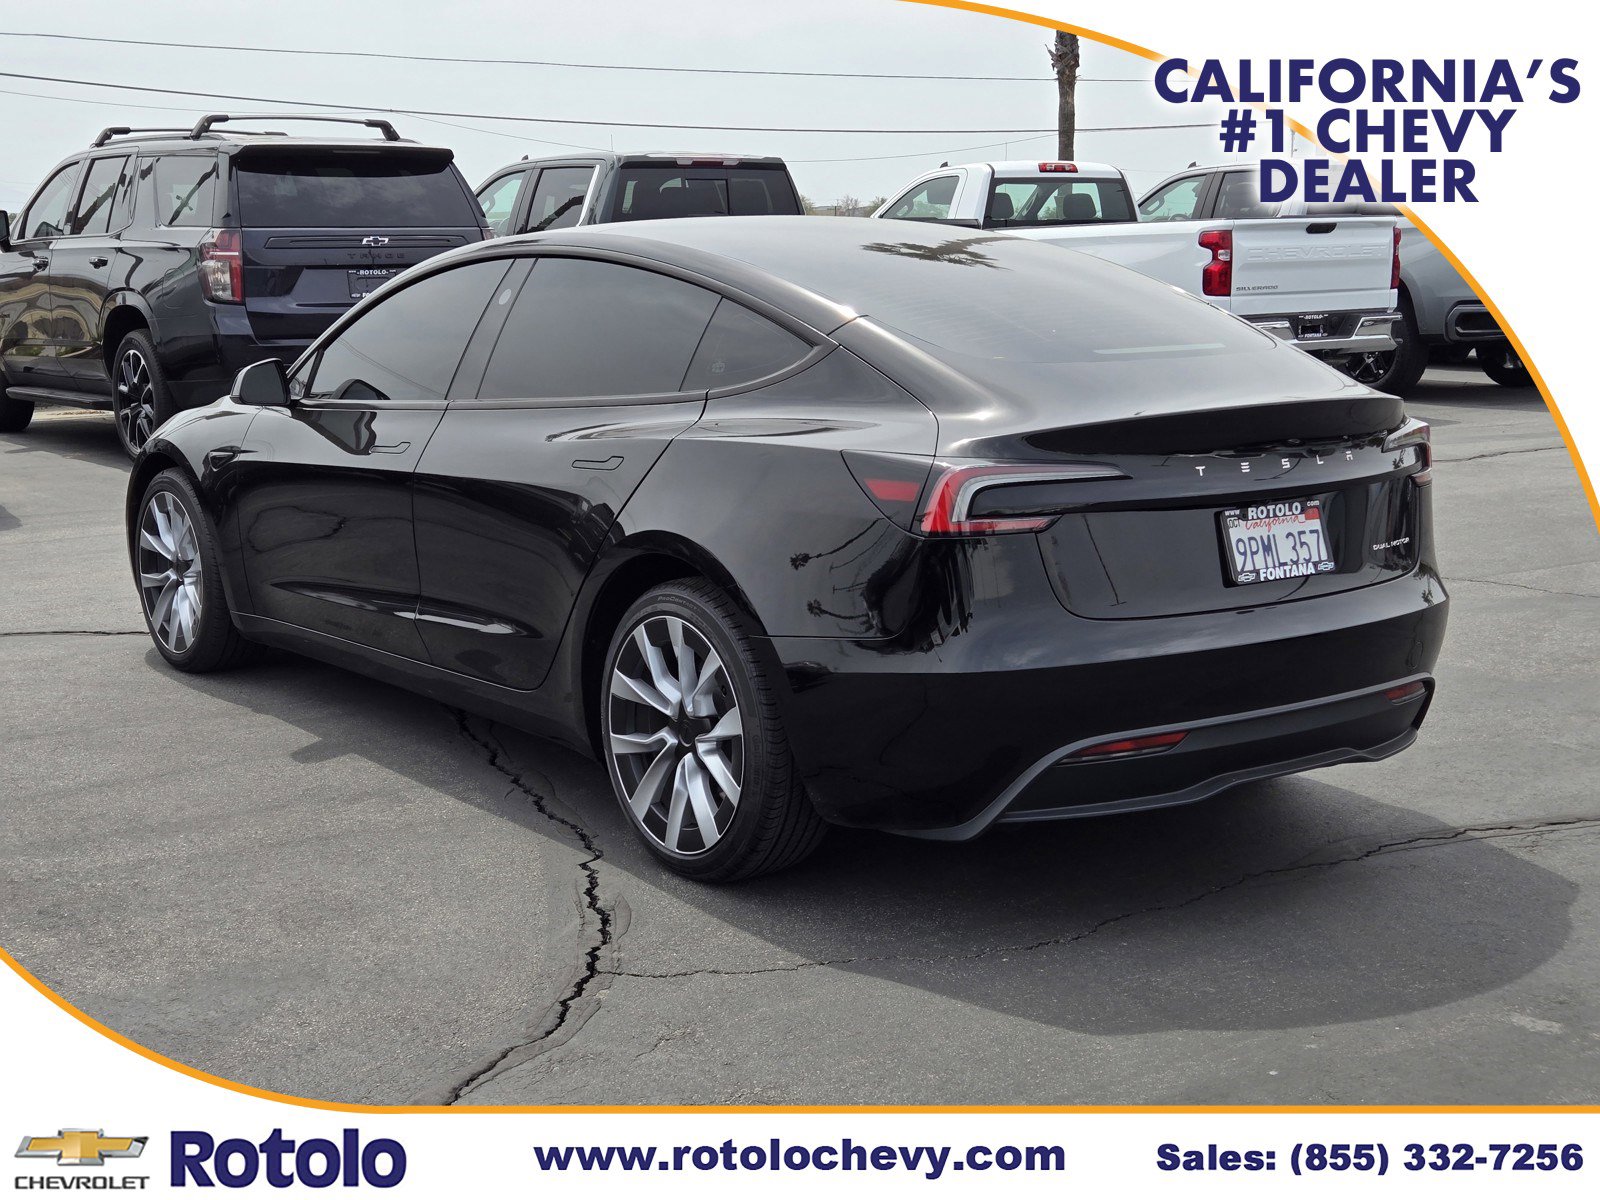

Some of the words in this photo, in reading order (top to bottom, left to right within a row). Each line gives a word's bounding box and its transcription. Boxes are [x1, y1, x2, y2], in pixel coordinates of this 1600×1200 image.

[1248, 244, 1387, 261] CHEVROLET
[1195, 451, 1354, 476] TESLA
[1247, 502, 1302, 520] ROTOLO
[1245, 514, 1305, 533] California
[1235, 529, 1321, 572] 9PML357
[1260, 562, 1316, 581] FONTANA
